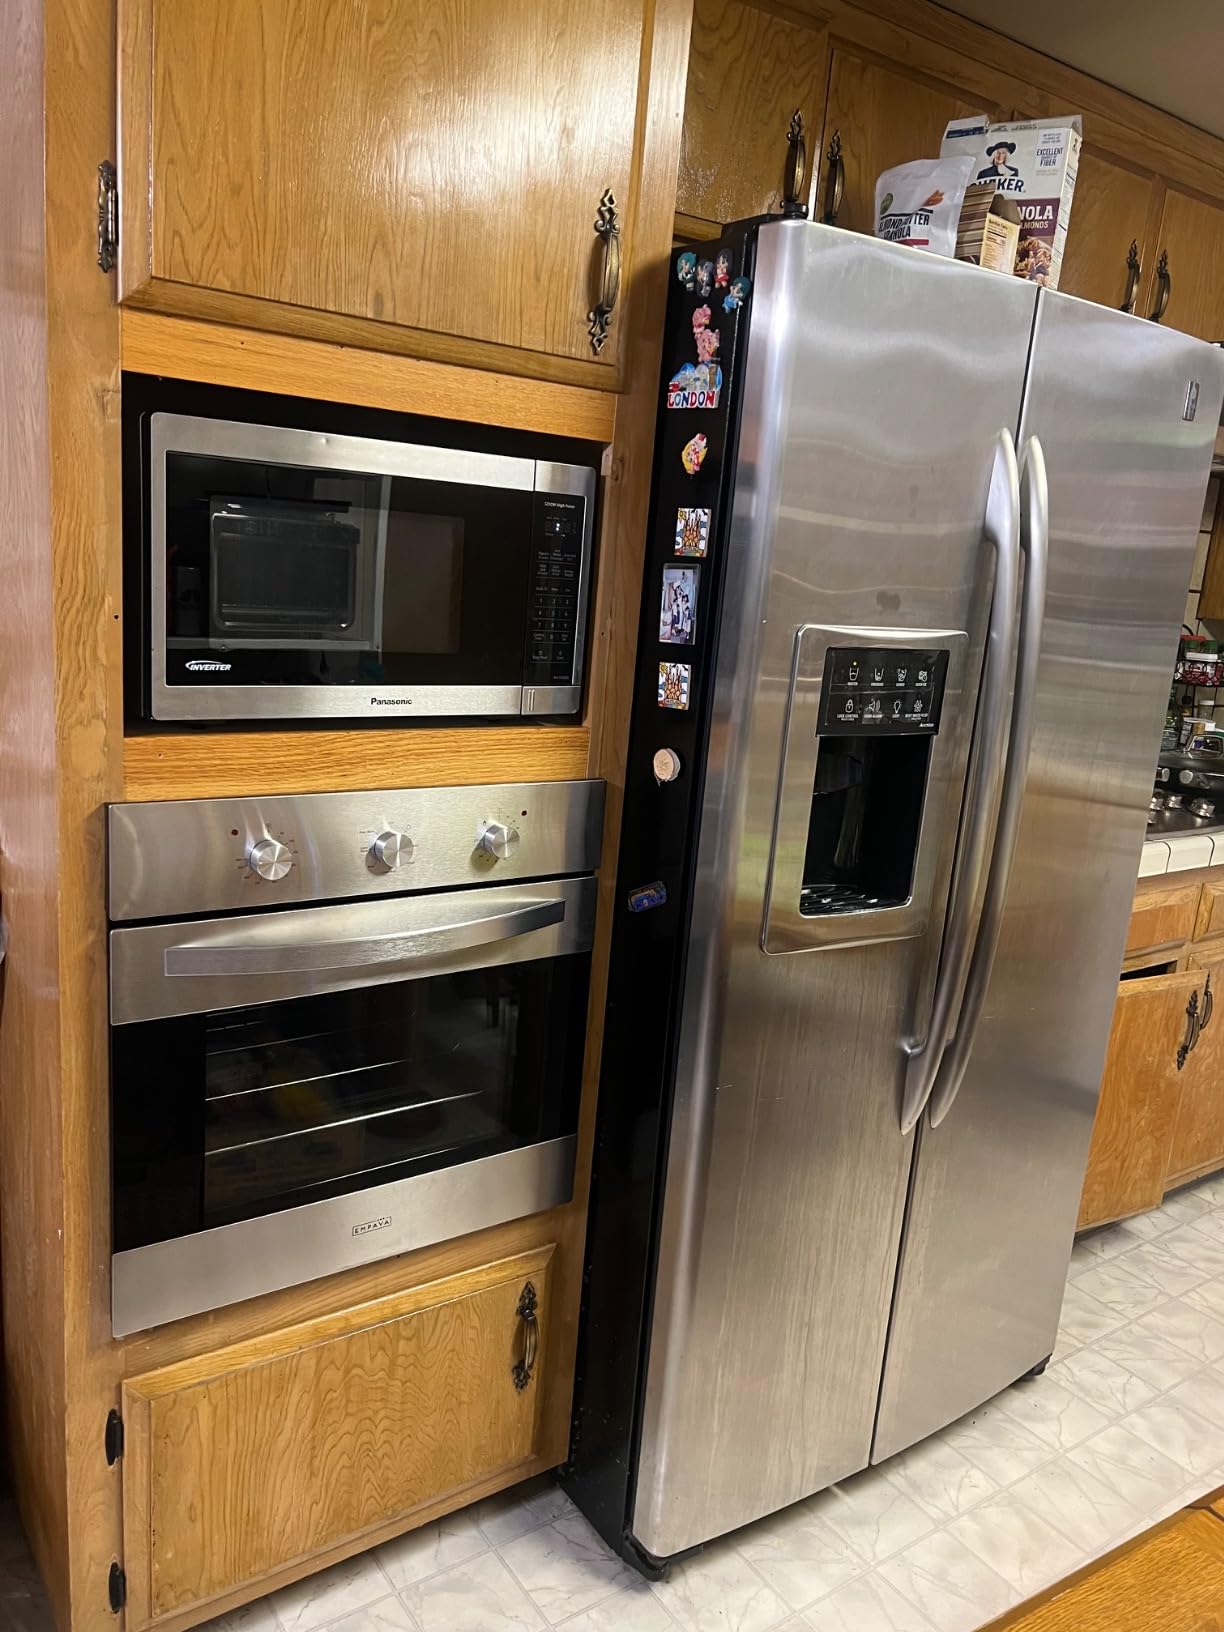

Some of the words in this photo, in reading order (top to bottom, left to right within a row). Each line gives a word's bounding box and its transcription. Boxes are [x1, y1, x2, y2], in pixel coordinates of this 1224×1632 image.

[668, 391, 716, 408] LONDON
[189, 663, 232, 671] INVERTER
[370, 697, 413, 706] Panasonic
